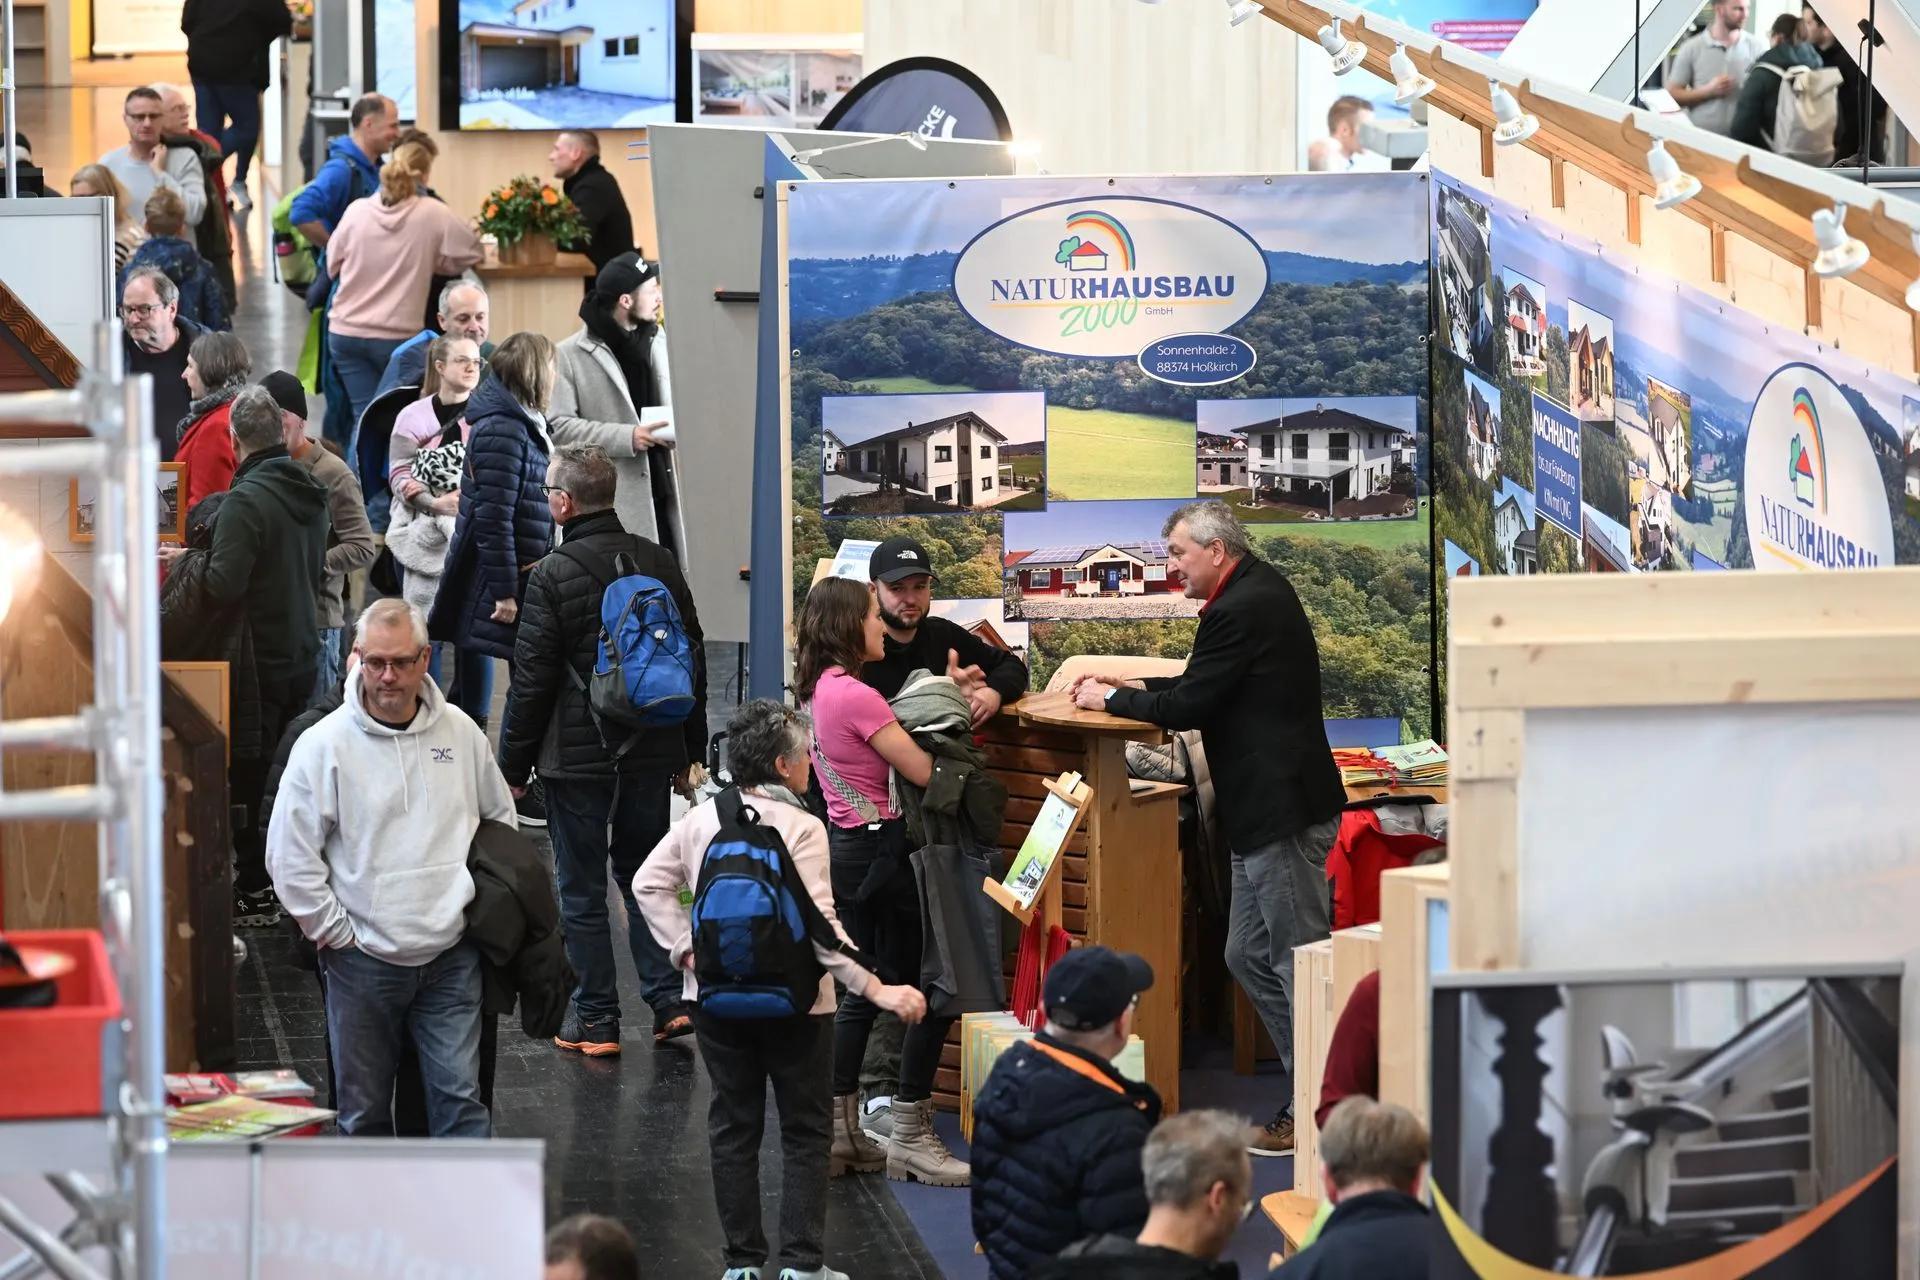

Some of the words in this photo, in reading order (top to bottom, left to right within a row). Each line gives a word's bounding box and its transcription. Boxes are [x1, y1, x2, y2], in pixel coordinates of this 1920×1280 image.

[991, 275, 1235, 301] NATURHAUSBAU
[1059, 296, 1139, 337] 2000
[1144, 306, 1174, 316] GmbH
[1157, 345, 1228, 356] Sonnenhalde
[1230, 344, 1237, 355] 2
[1156, 362, 1189, 373] 88374
[1191, 361, 1238, 373] Hoßkirch
[1533, 408, 1579, 459] NACHHALTIG
[1552, 459, 1576, 495] Förderung
